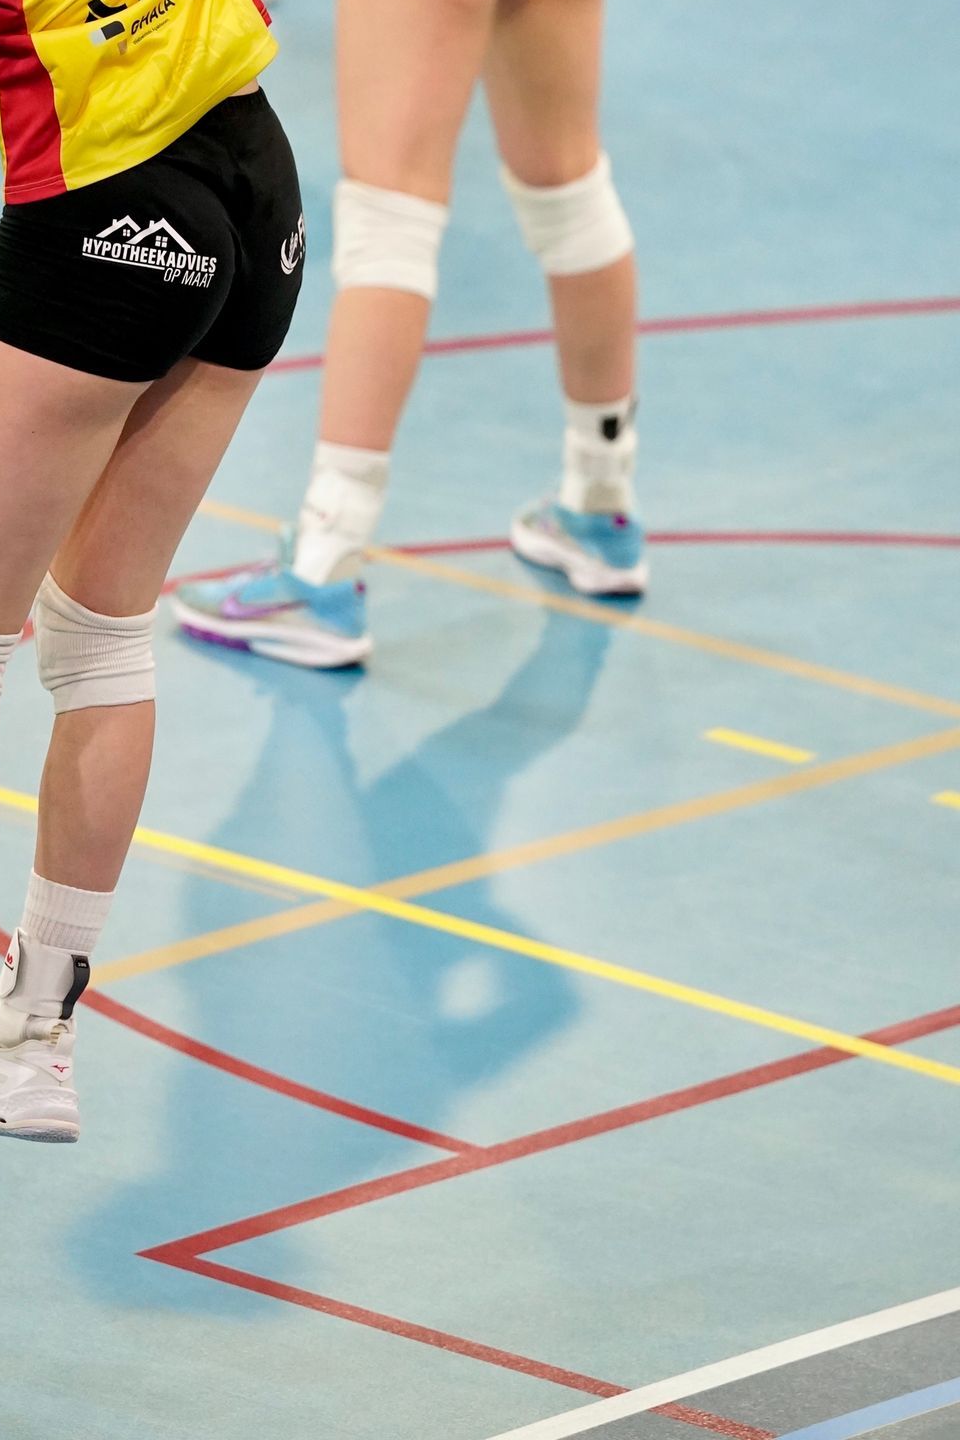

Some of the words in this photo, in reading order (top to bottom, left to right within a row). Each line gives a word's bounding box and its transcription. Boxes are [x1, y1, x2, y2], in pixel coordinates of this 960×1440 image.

[82, 237, 217, 273] HYPOTHEEKADVIES
[163, 267, 181, 282] OP
[181, 270, 215, 288] MAAT
